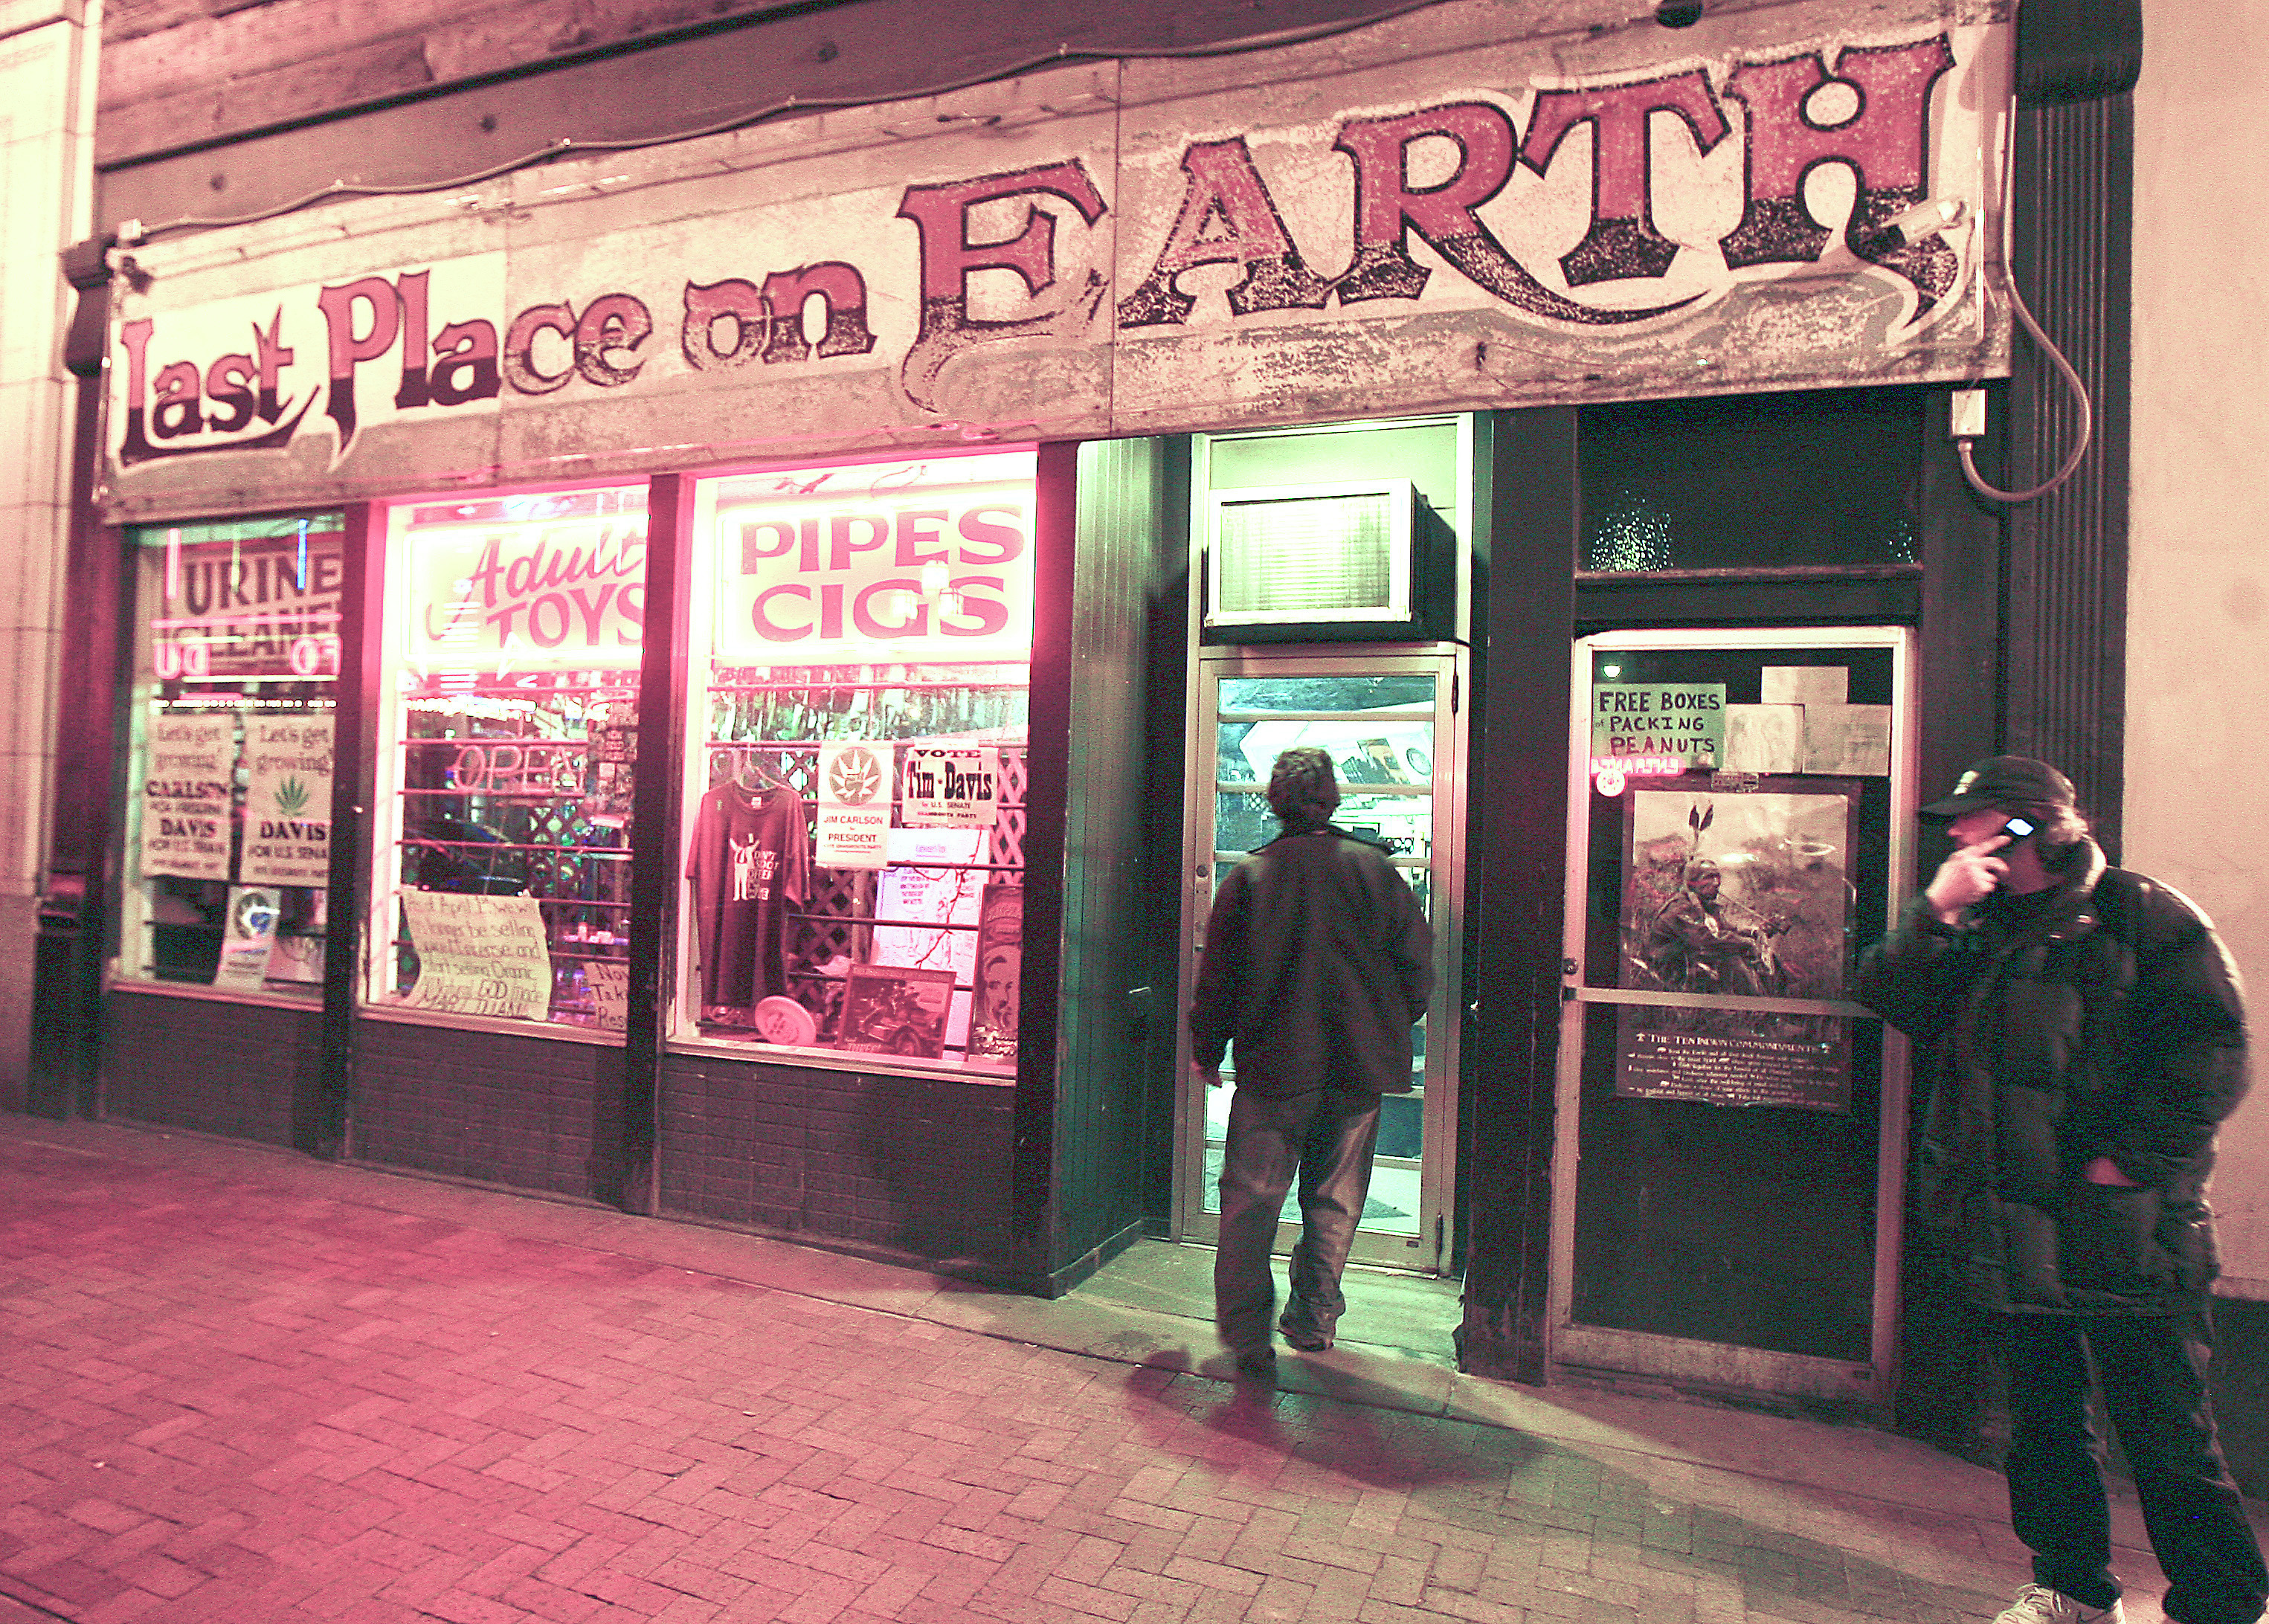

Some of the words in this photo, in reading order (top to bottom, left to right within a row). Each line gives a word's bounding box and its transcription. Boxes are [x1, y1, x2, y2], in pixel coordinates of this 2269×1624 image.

[120, 302, 322, 468] Last
[318, 268, 653, 457] Place
[681, 260, 878, 372] on
[897, 33, 1957, 413] EARTH
[741, 506, 1025, 574] PIPES
[187, 552, 342, 616] URINE
[425, 529, 647, 641] Adult
[487, 582, 646, 648] TOYS
[752, 576, 1008, 642] CIGS
[1600, 692, 1651, 712] FREE
[1661, 692, 1720, 710] BOXES
[1610, 716, 1704, 732] PACKING
[914, 749, 981, 758] VOTE
[1610, 736, 1714, 755] PEANUTS
[454, 744, 588, 794] OPEN
[907, 761, 934, 799] Tim
[944, 761, 992, 800] Davis
[260, 820, 326, 841] DAVIS
[828, 833, 876, 842] PRESIDENT
[840, 816, 883, 825] CARLSON
